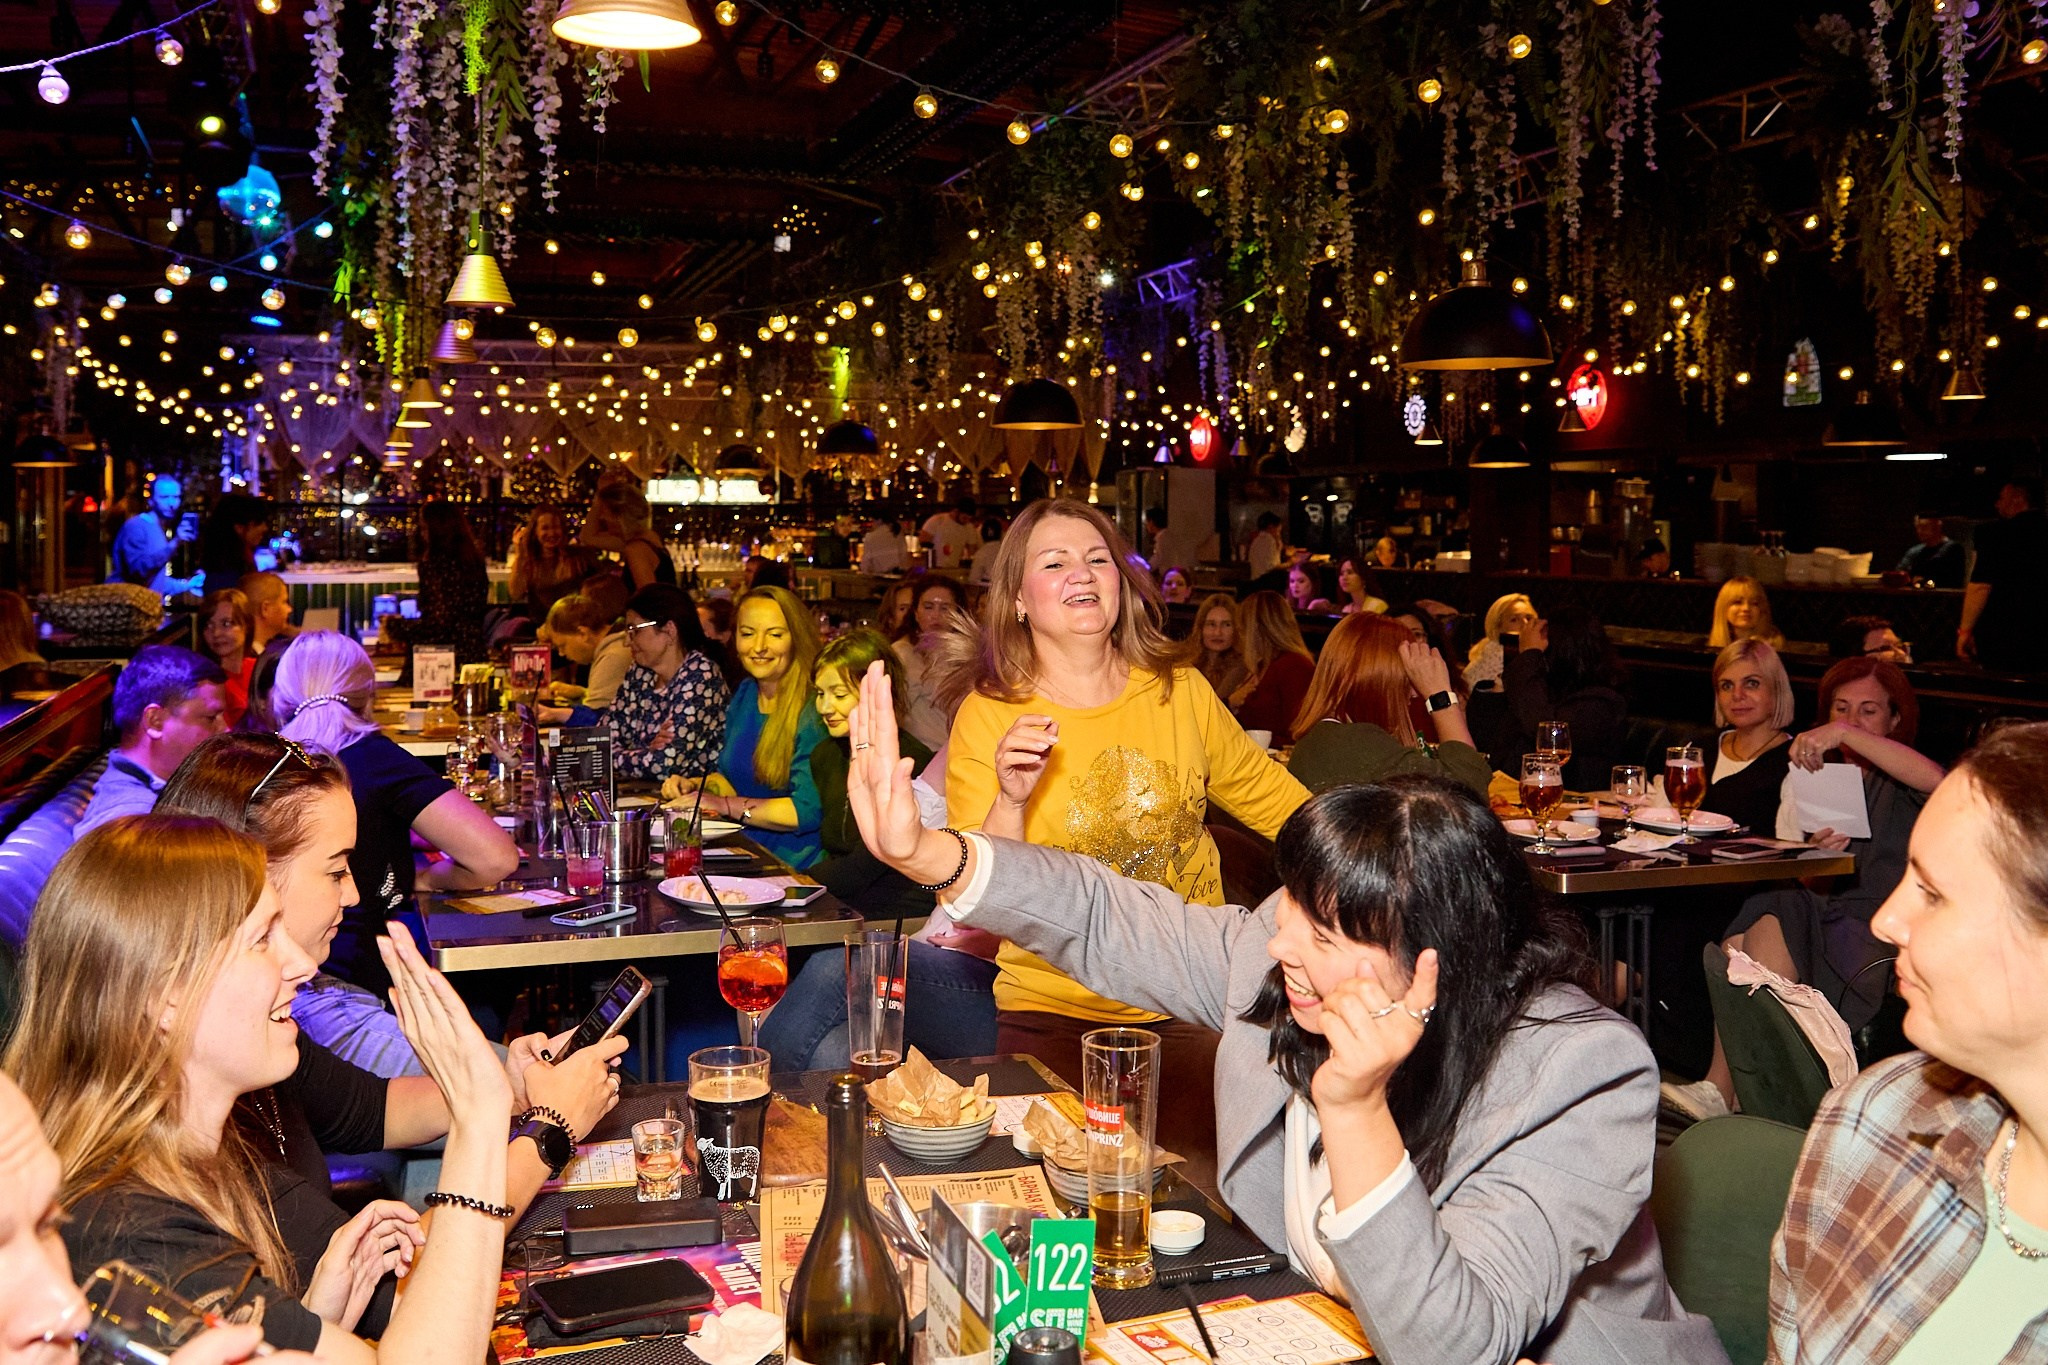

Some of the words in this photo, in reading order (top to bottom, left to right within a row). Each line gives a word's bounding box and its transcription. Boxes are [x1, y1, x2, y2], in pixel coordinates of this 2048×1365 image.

[1017, 1175, 1043, 1204] БАРНАЯ
[715, 1261, 761, 1297] БИЛЕТ
[1034, 1242, 1088, 1292] 122
